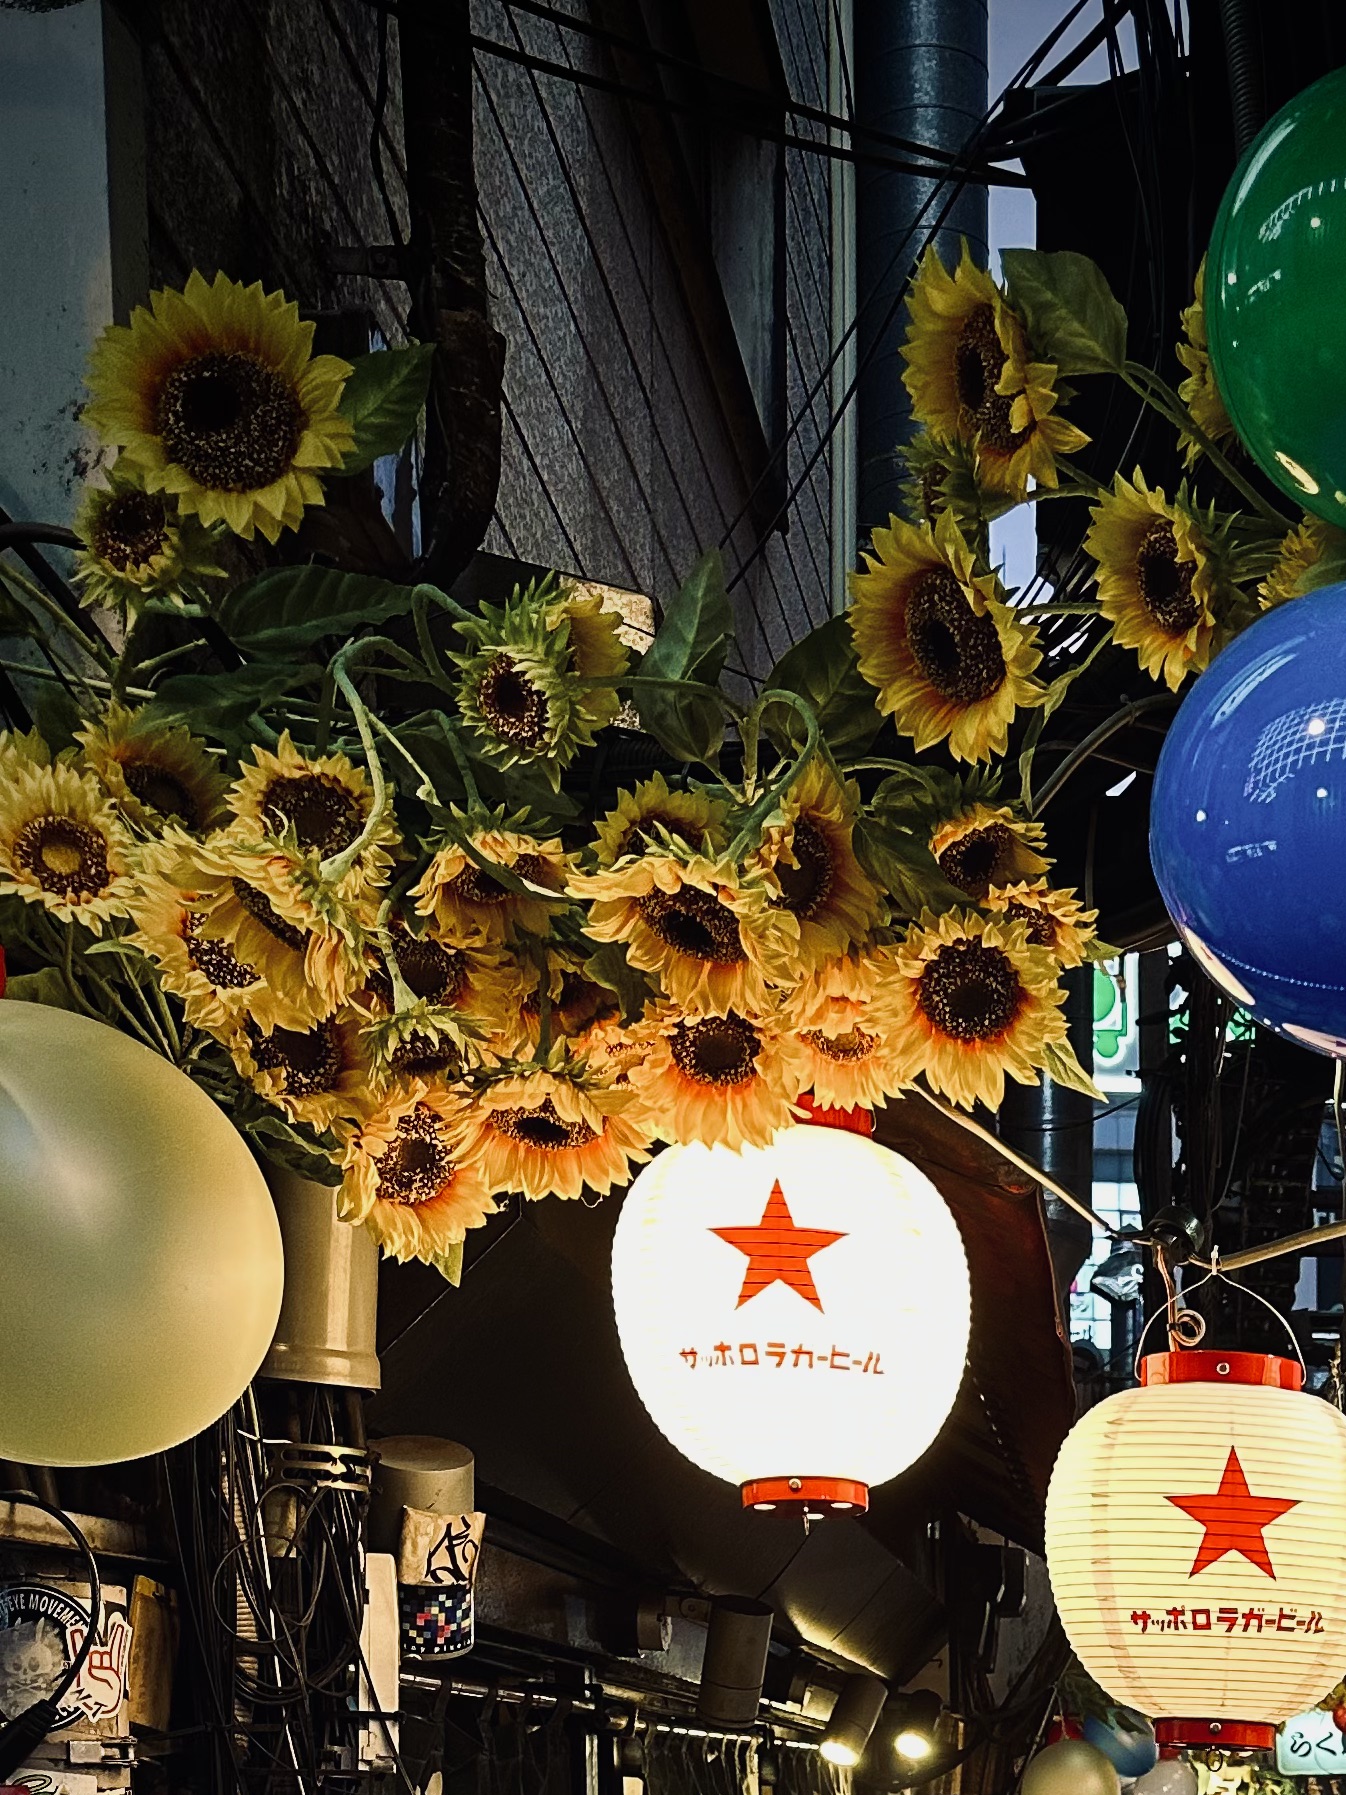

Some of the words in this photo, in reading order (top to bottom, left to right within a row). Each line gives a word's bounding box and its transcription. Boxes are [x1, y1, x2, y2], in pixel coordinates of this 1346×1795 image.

[1131, 1606, 1326, 1635] サッポロラガービール
[1290, 1731, 1337, 1757] らく
